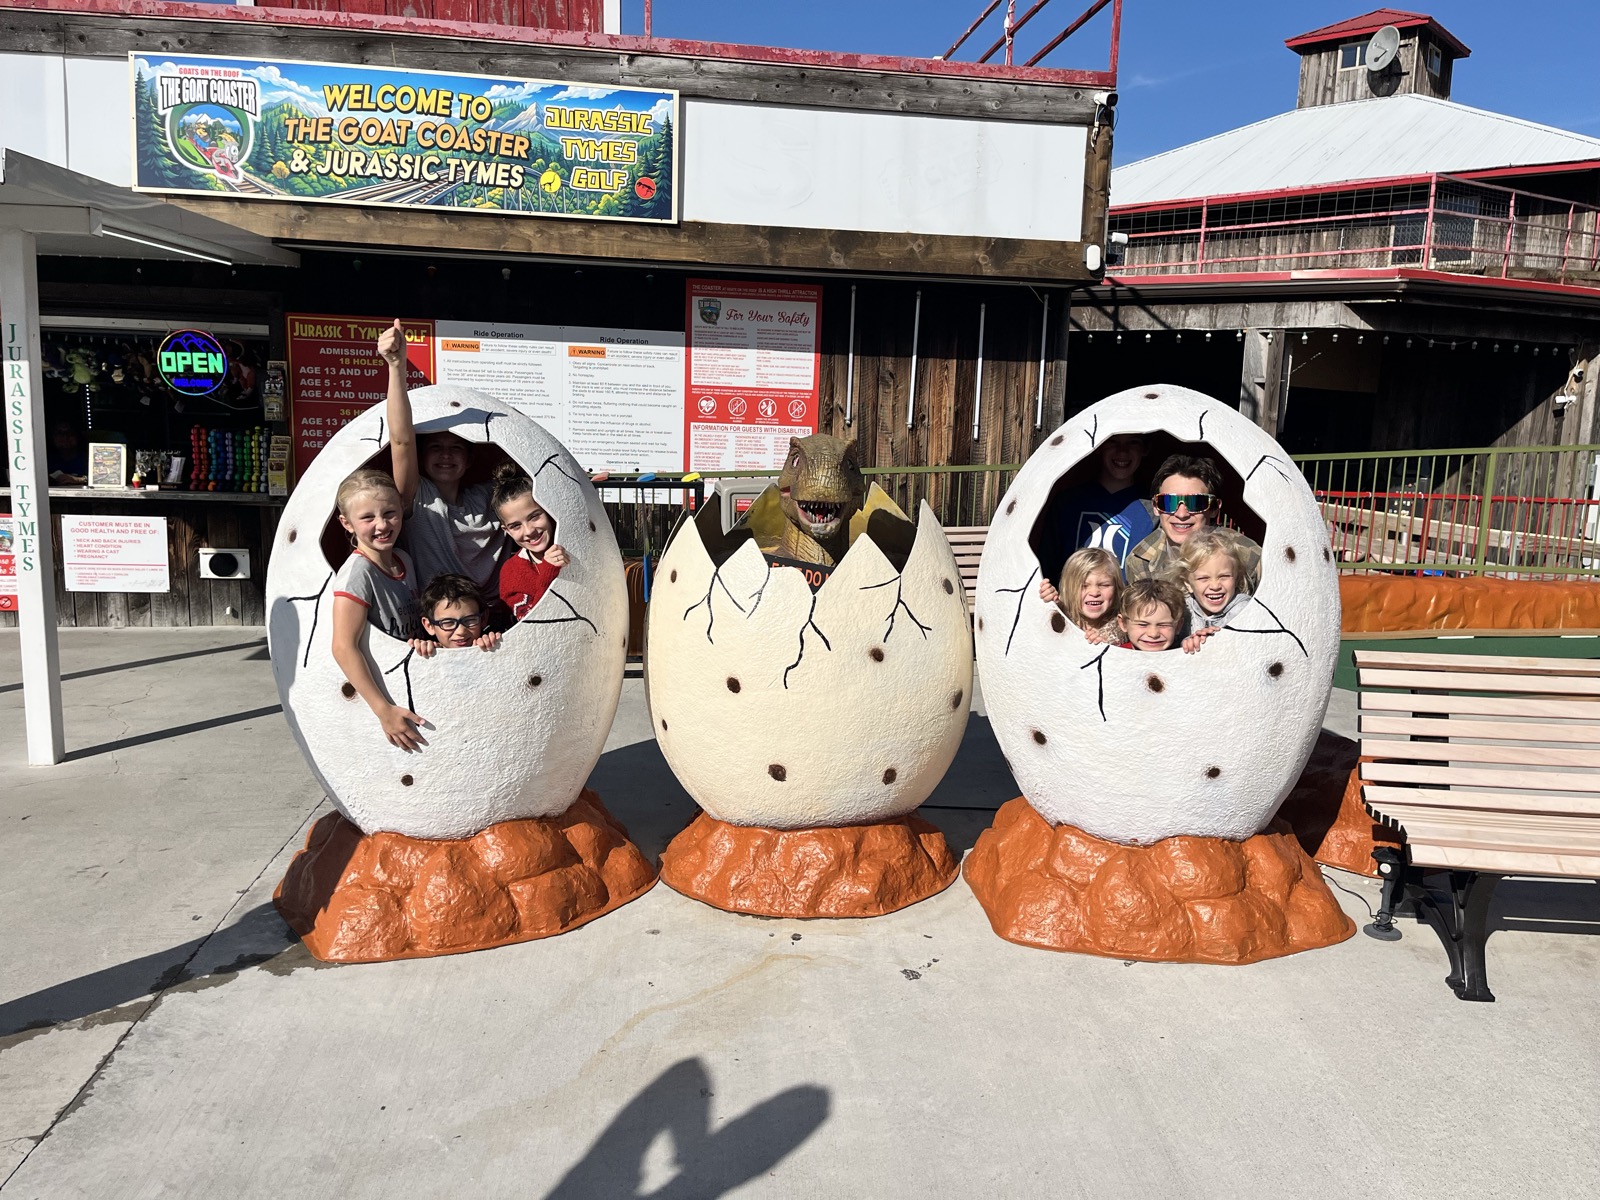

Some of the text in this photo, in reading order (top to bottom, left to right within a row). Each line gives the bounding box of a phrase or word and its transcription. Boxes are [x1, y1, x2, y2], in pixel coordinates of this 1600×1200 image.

[179, 67, 199, 76] GOATS
[200, 68, 209, 76] ON
[210, 69, 222, 77] THE
[161, 77, 256, 115] THE GOAT COASTER
[323, 84, 492, 121] WELCOME TO
[545, 106, 653, 135] JURASSIC
[284, 117, 530, 159] THE GOAT COASTER
[561, 137, 637, 163] TYMES
[290, 149, 525, 189] & JURASSIC TYMES
[572, 168, 628, 192] GOLF
[725, 308, 810, 327] For Your Safety
[293, 321, 342, 339] JURASSIC
[490, 330, 524, 339] Operation
[616, 337, 649, 345] Operation
[319, 347, 373, 356] ADMISSION
[161, 351, 224, 374] OPEN
[339, 357, 384, 367] 18 HOLES
[299, 366, 321, 374] AGE
[324, 367, 336, 375] 13
[339, 368, 361, 376] AND
[364, 368, 378, 377] UP
[299, 378, 322, 386] AGE
[324, 379, 331, 387] 5
[339, 380, 352, 388] 12
[300, 390, 387, 400] AGE 4 AND UNDE
[340, 408, 351, 416] 36
[301, 417, 323, 425] AGE
[325, 418, 338, 426] 13
[301, 429, 323, 437] AGE
[692, 424, 729, 432] INFORMATION
[8, 323, 37, 572] JURASSIC TYMES
[302, 440, 324, 448] AGE
